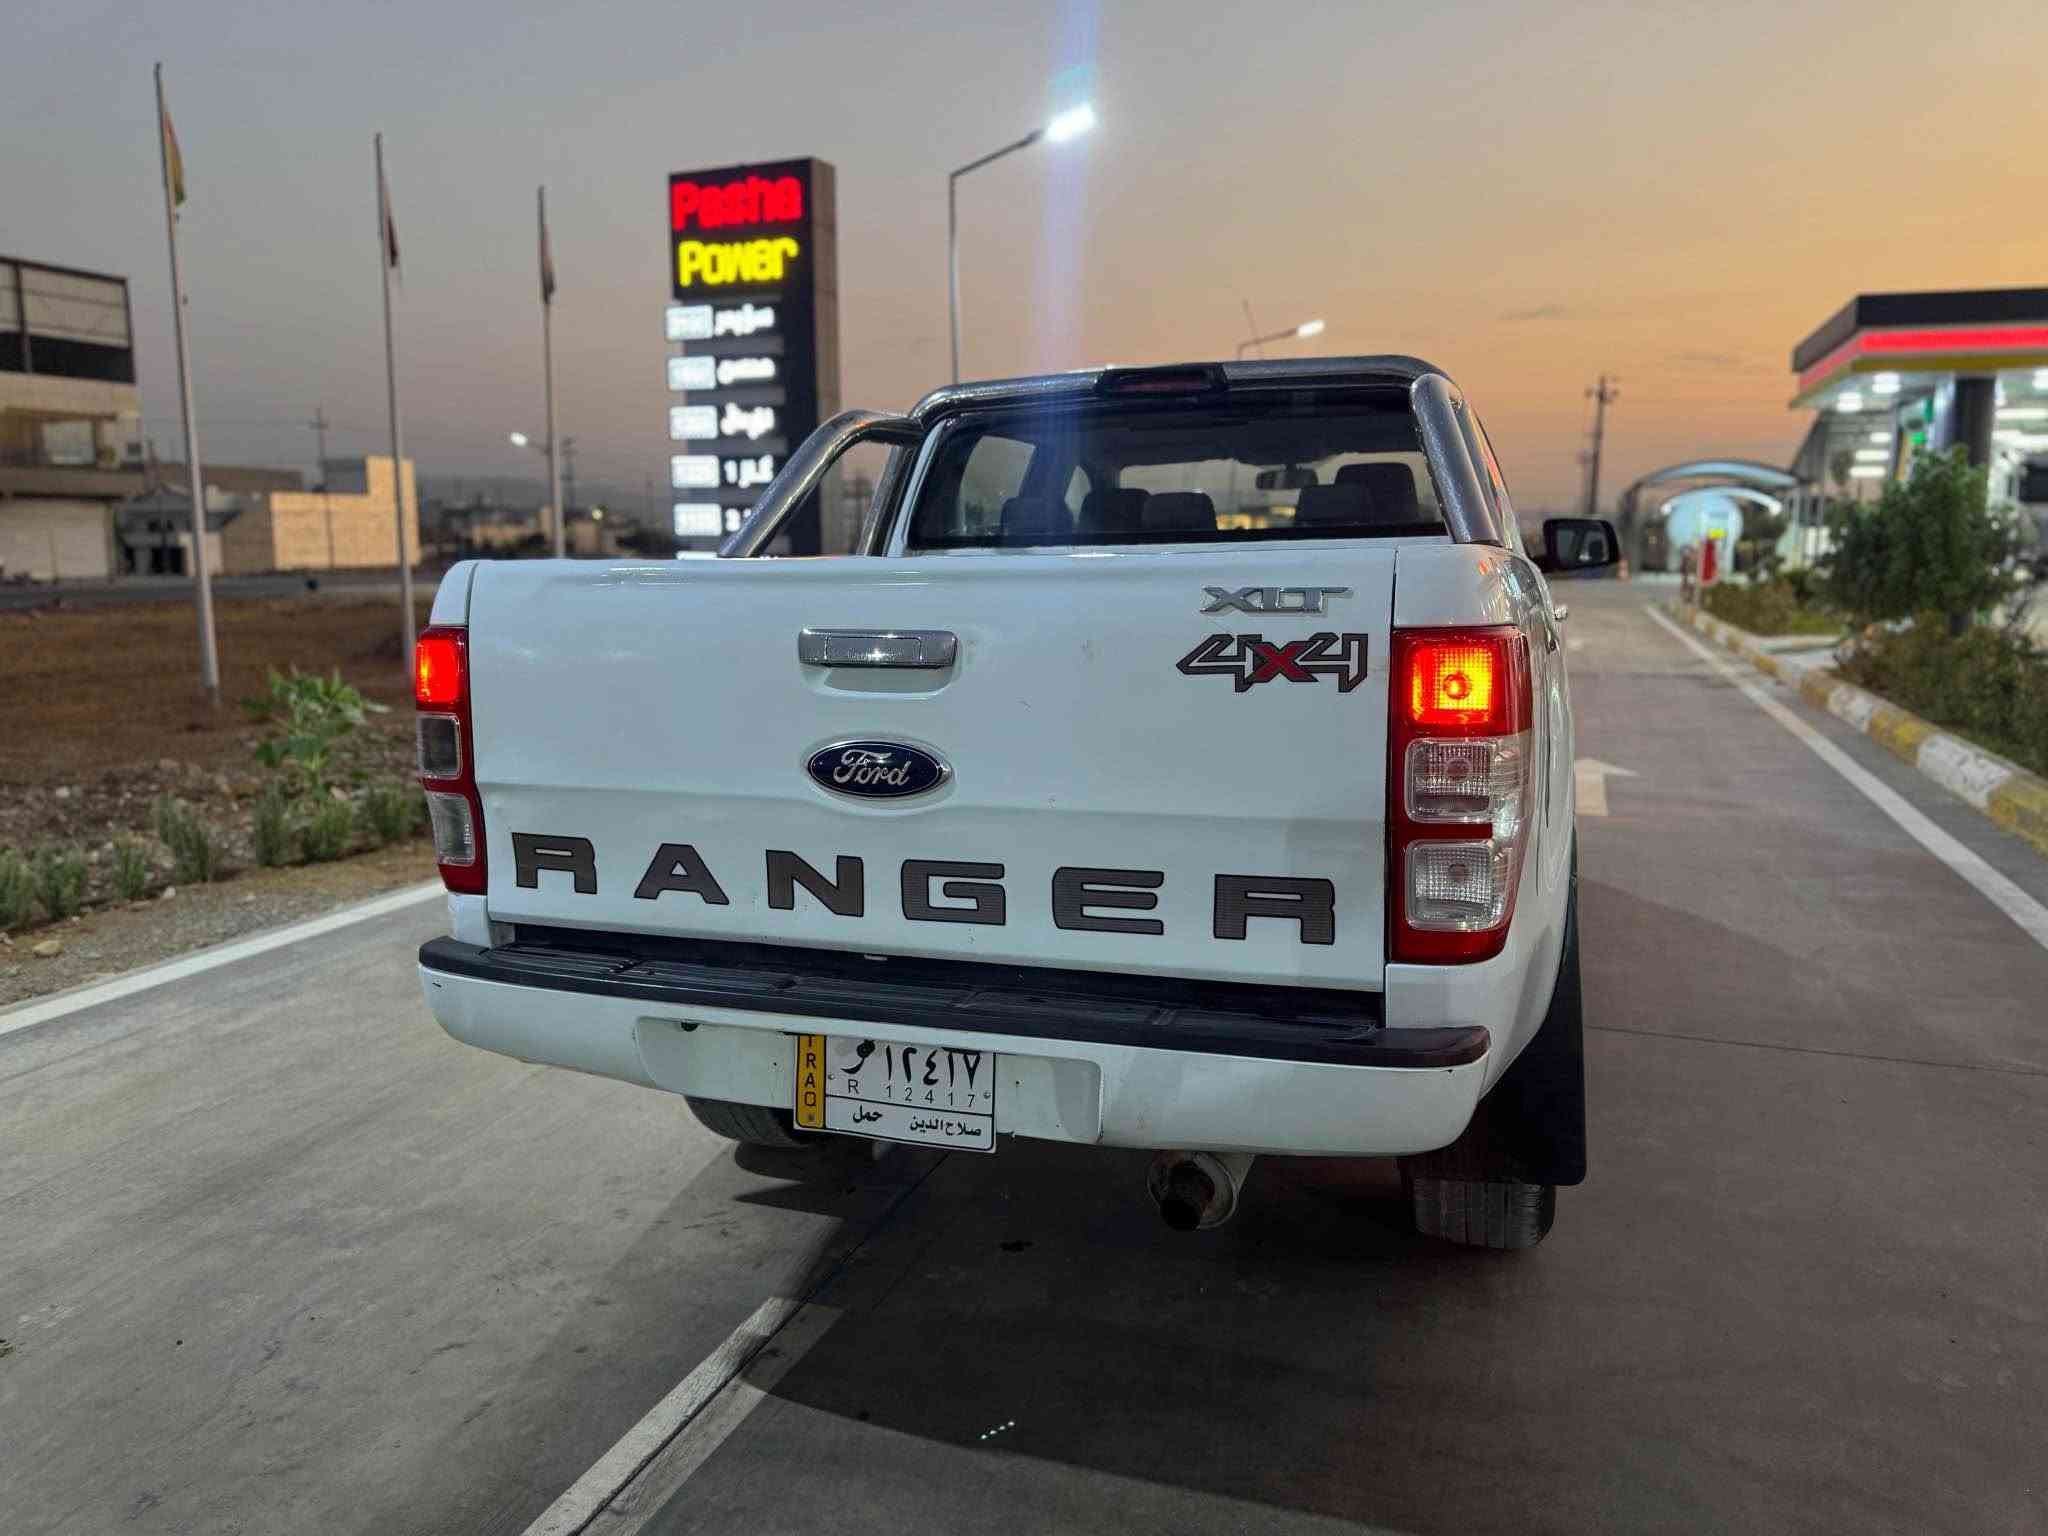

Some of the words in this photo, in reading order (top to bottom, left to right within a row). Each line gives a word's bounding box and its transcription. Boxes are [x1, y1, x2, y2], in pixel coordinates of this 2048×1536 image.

[679, 238, 798, 286] Power
[1200, 586, 1352, 613] XLT
[833, 750, 911, 786] Ford
[511, 832, 1335, 945] RANGER
[885, 1045, 981, 1089] ١٢٤١٧
[848, 1079, 859, 1095] R
[886, 1085, 975, 1108] 12417
[853, 1104, 883, 1124] حمل
[910, 1115, 943, 1134] الدين
[945, 1121, 982, 1137] صلاح
